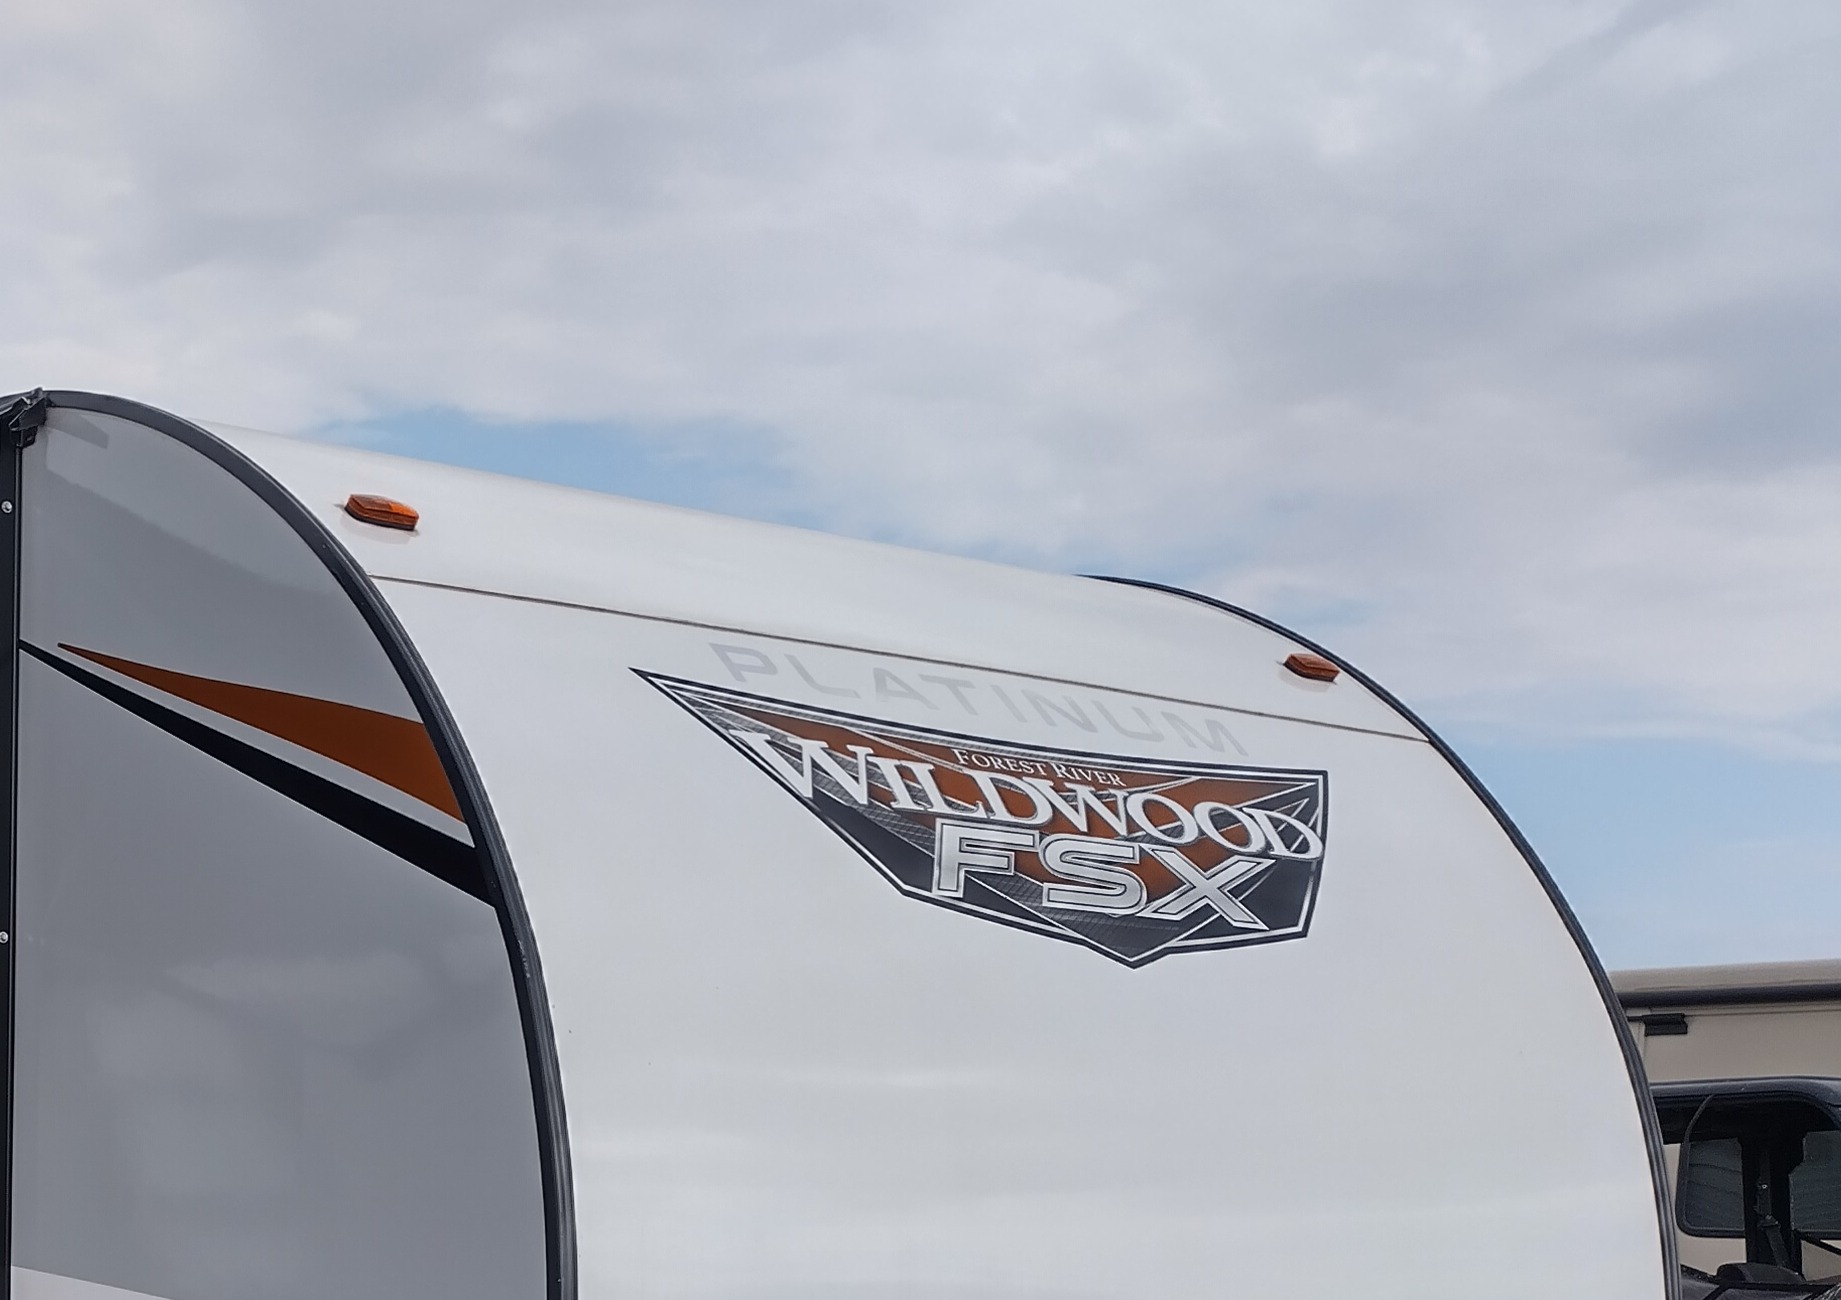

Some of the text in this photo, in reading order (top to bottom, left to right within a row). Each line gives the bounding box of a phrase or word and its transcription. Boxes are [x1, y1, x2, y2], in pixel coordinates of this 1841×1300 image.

[709, 642, 1248, 757] PLATINUM
[727, 730, 1323, 860] WILDWOOD
[951, 748, 1127, 787] FOREST RIVER
[933, 818, 1275, 931] FSX
